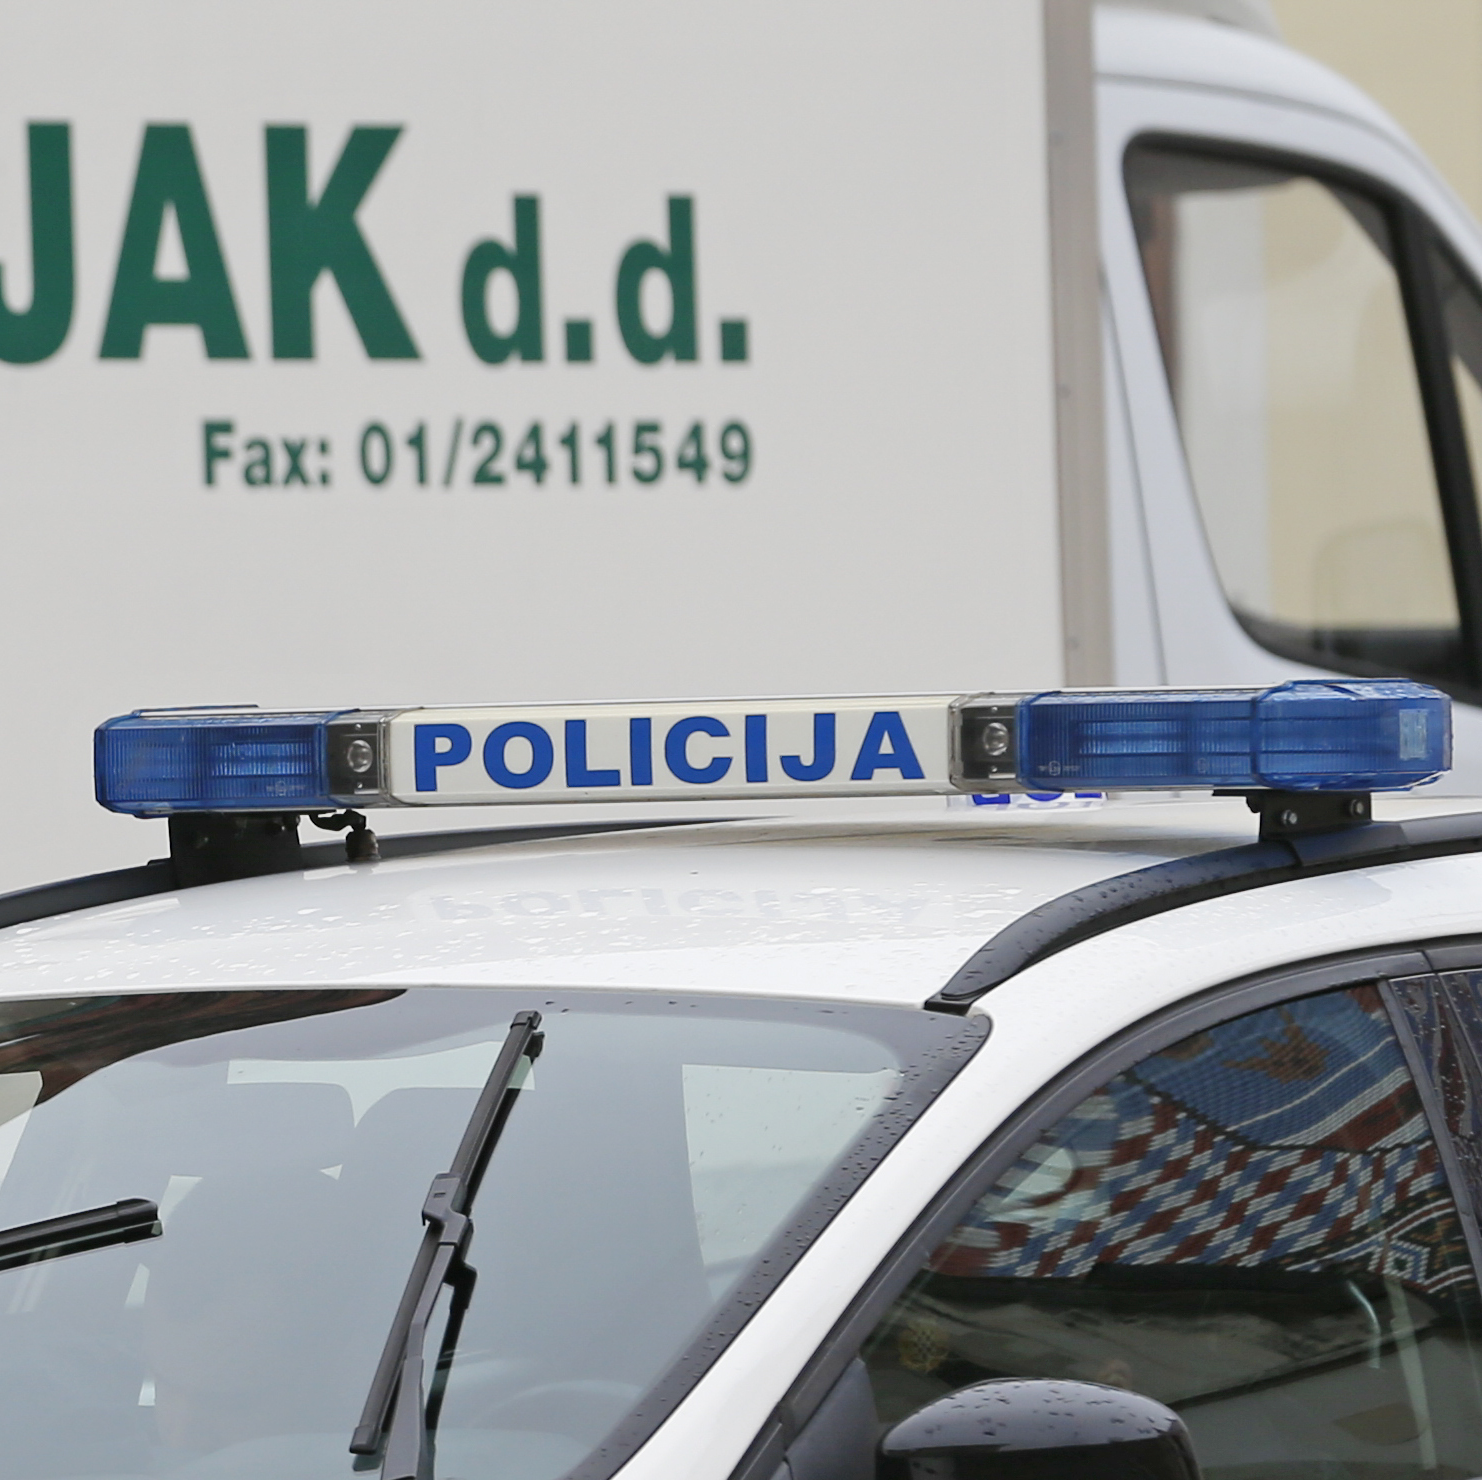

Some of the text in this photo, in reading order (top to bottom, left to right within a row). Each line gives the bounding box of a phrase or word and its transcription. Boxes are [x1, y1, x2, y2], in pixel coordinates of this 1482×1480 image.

[459, 193, 751, 367] d.d.
[202, 418, 753, 488] Fax: 01/2411549
[413, 709, 927, 792] POLICIJA
